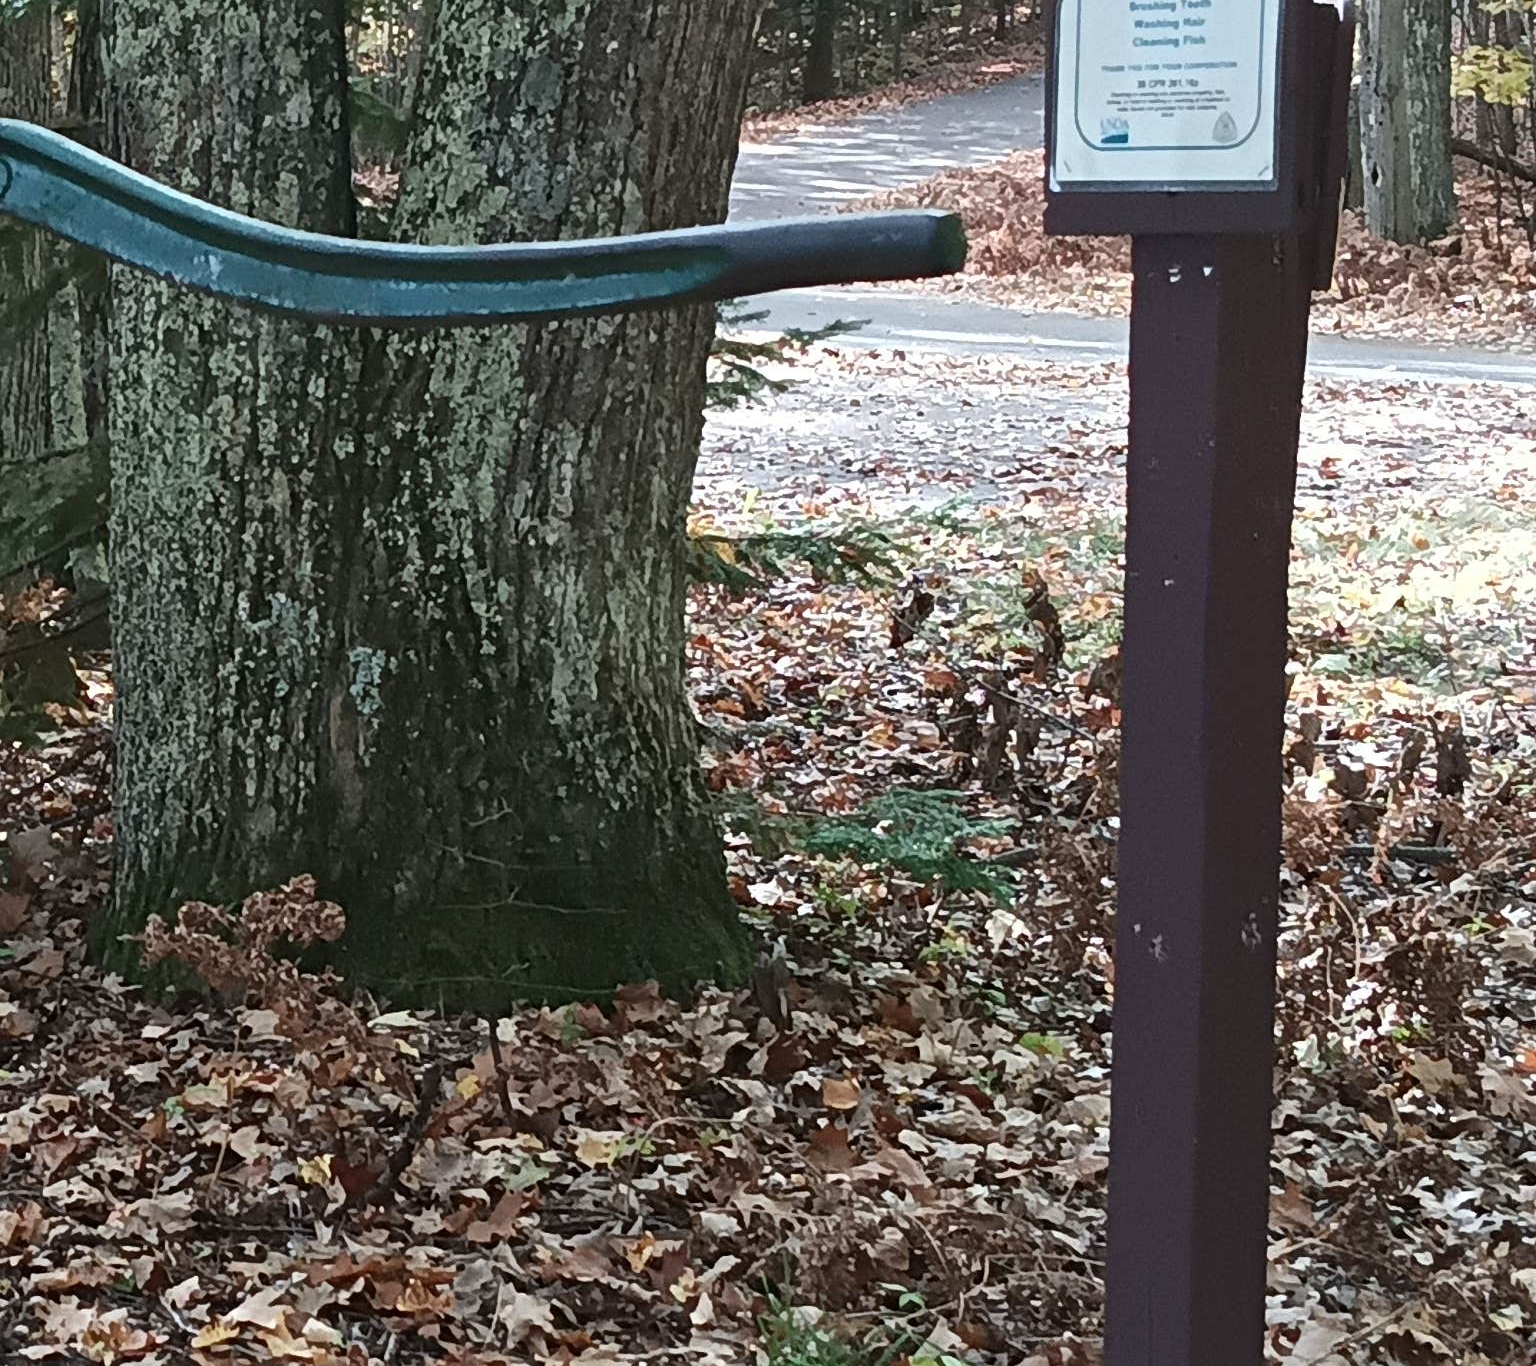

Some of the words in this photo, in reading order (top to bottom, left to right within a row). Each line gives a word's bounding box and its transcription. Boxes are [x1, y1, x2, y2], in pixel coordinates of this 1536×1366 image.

[1129, 1, 1176, 12] Brushing
[1134, 20, 1179, 30] Washing
[1132, 37, 1179, 47] Cleaning
[1183, 35, 1205, 44] Fish
